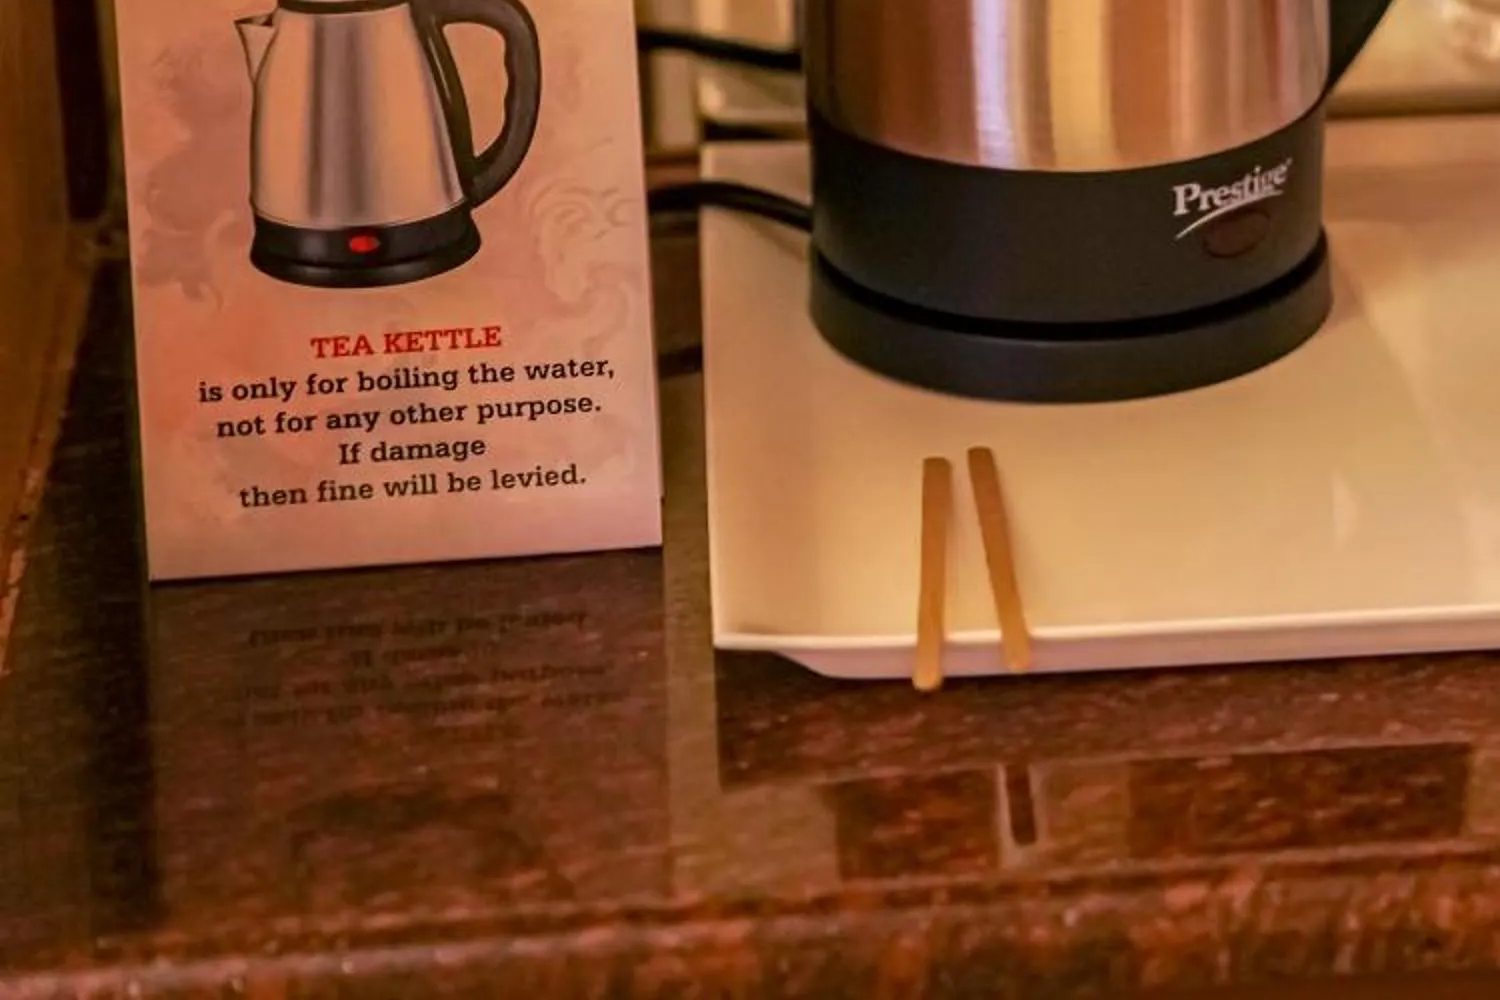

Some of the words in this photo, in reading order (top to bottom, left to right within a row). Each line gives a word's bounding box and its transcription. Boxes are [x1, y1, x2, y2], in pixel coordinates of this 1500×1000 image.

[1172, 164, 1289, 216] Prestige
[310, 333, 375, 359] TEA
[383, 325, 502, 354] KETTLE
[199, 380, 223, 403] is
[231, 376, 297, 403] only
[305, 372, 348, 396] for
[357, 365, 459, 392] boiling
[467, 363, 516, 385] the
[523, 358, 615, 380] water,
[216, 414, 266, 438] not
[274, 411, 317, 434] for
[325, 409, 381, 433] any
[389, 402, 468, 426] other
[476, 396, 602, 425] purpose.
[339, 441, 363, 466] If
[369, 438, 487, 462] damage
[239, 484, 308, 508] then
[316, 479, 374, 503] fine
[383, 473, 438, 498] will
[446, 471, 482, 493] be
[488, 463, 587, 491] levied.
